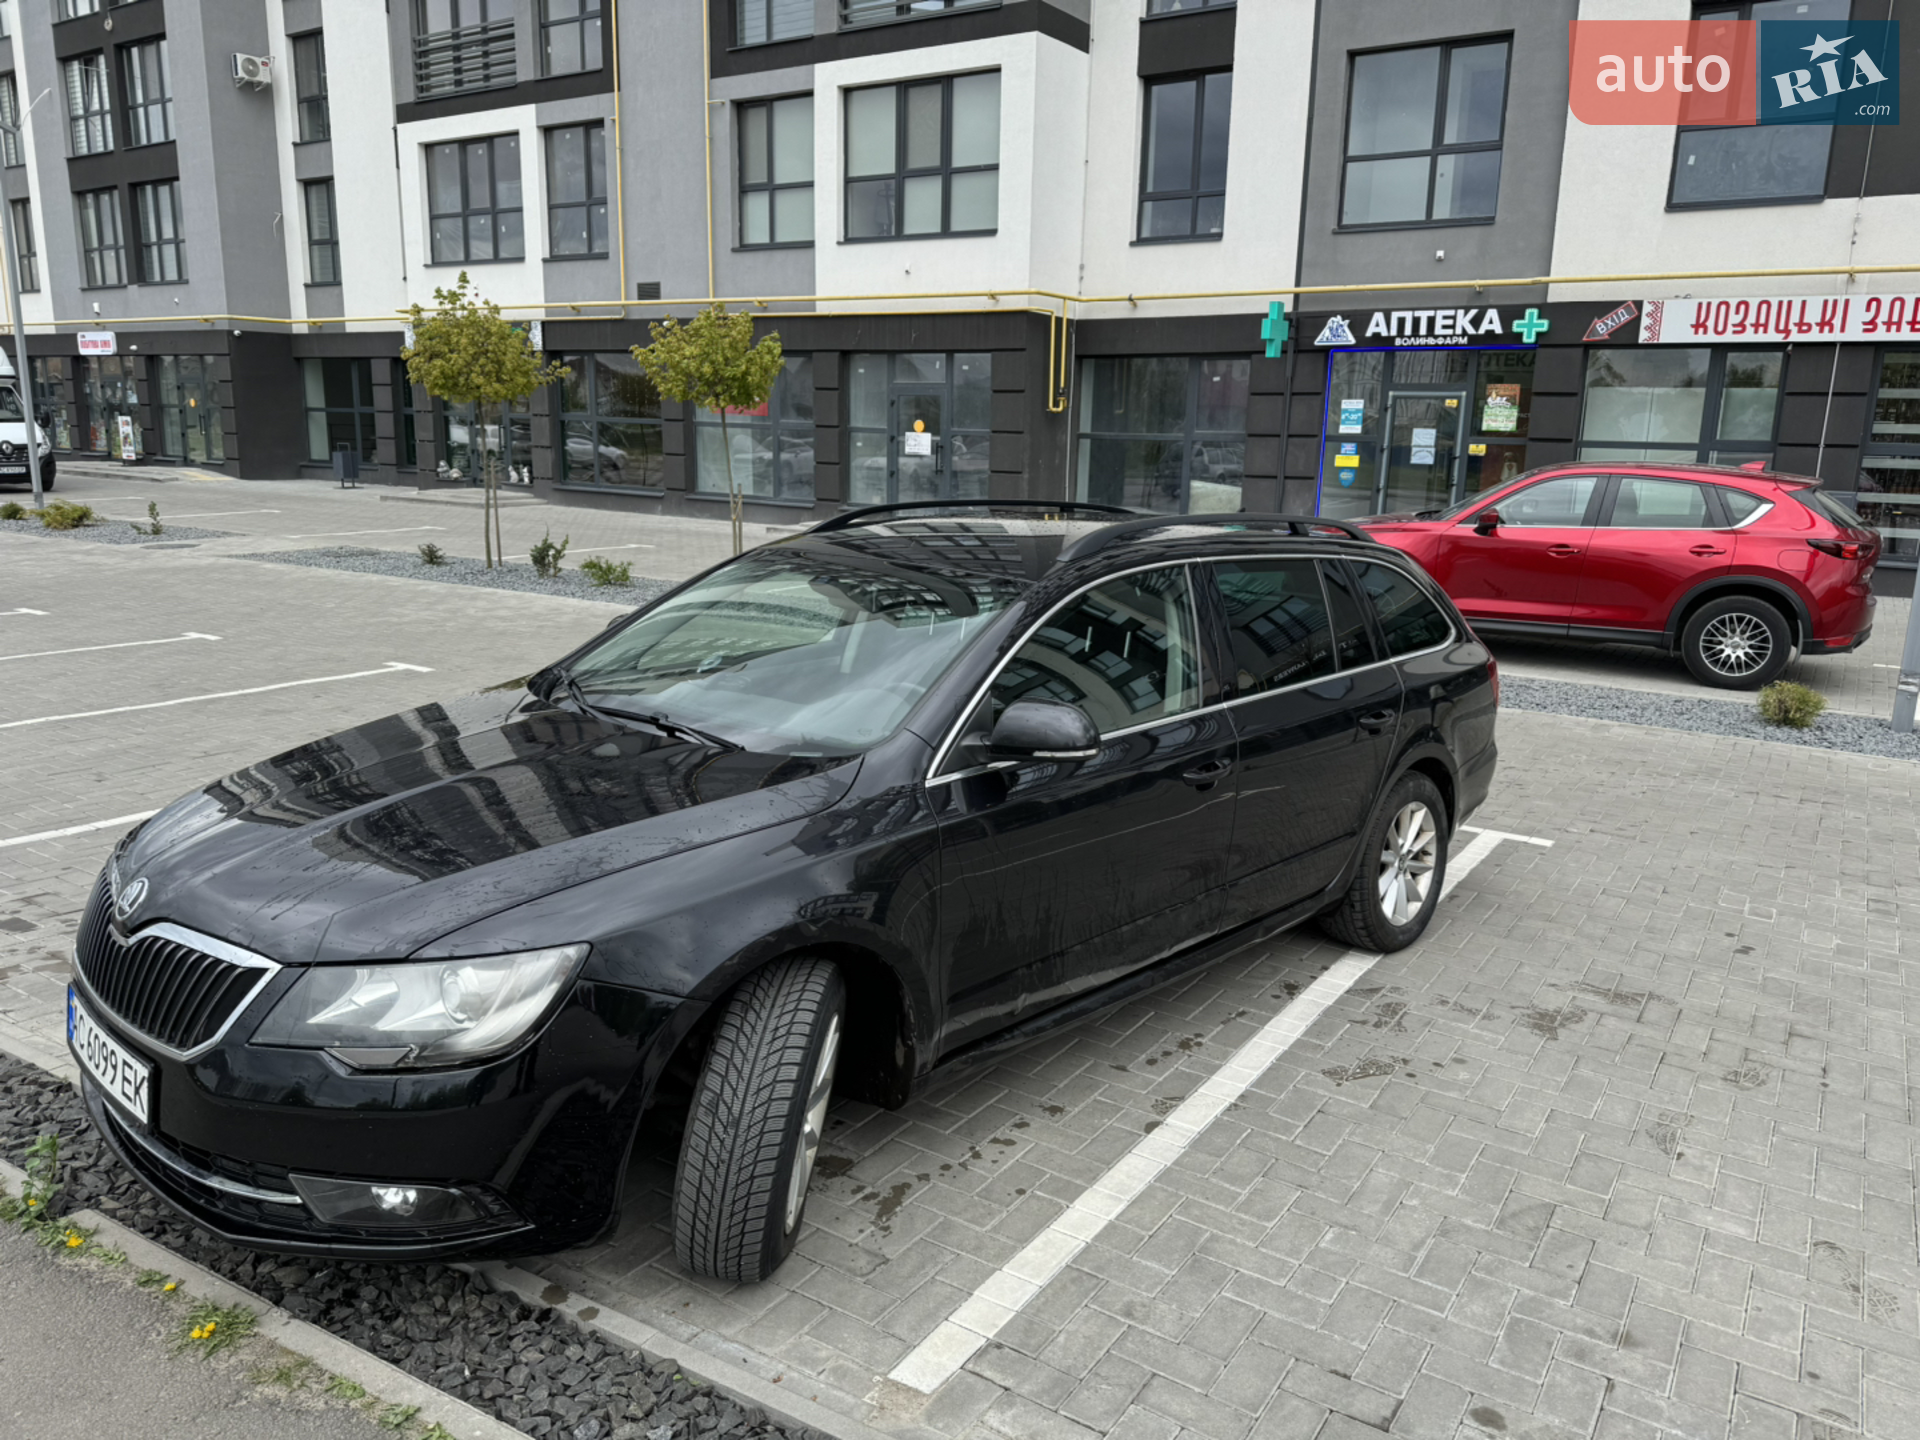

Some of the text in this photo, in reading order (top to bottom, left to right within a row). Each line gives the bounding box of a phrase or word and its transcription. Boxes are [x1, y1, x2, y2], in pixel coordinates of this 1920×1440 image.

[1365, 308, 1503, 337] АПТЕКА
[1595, 309, 1630, 334] ВХІД
[1690, 298, 1850, 340] КОЗАЦЬКІ
[1394, 336, 1468, 346] ВОЛИНЬФАРМ
[87, 1026, 118, 1085] 6099
[122, 1058, 146, 1114] EK
